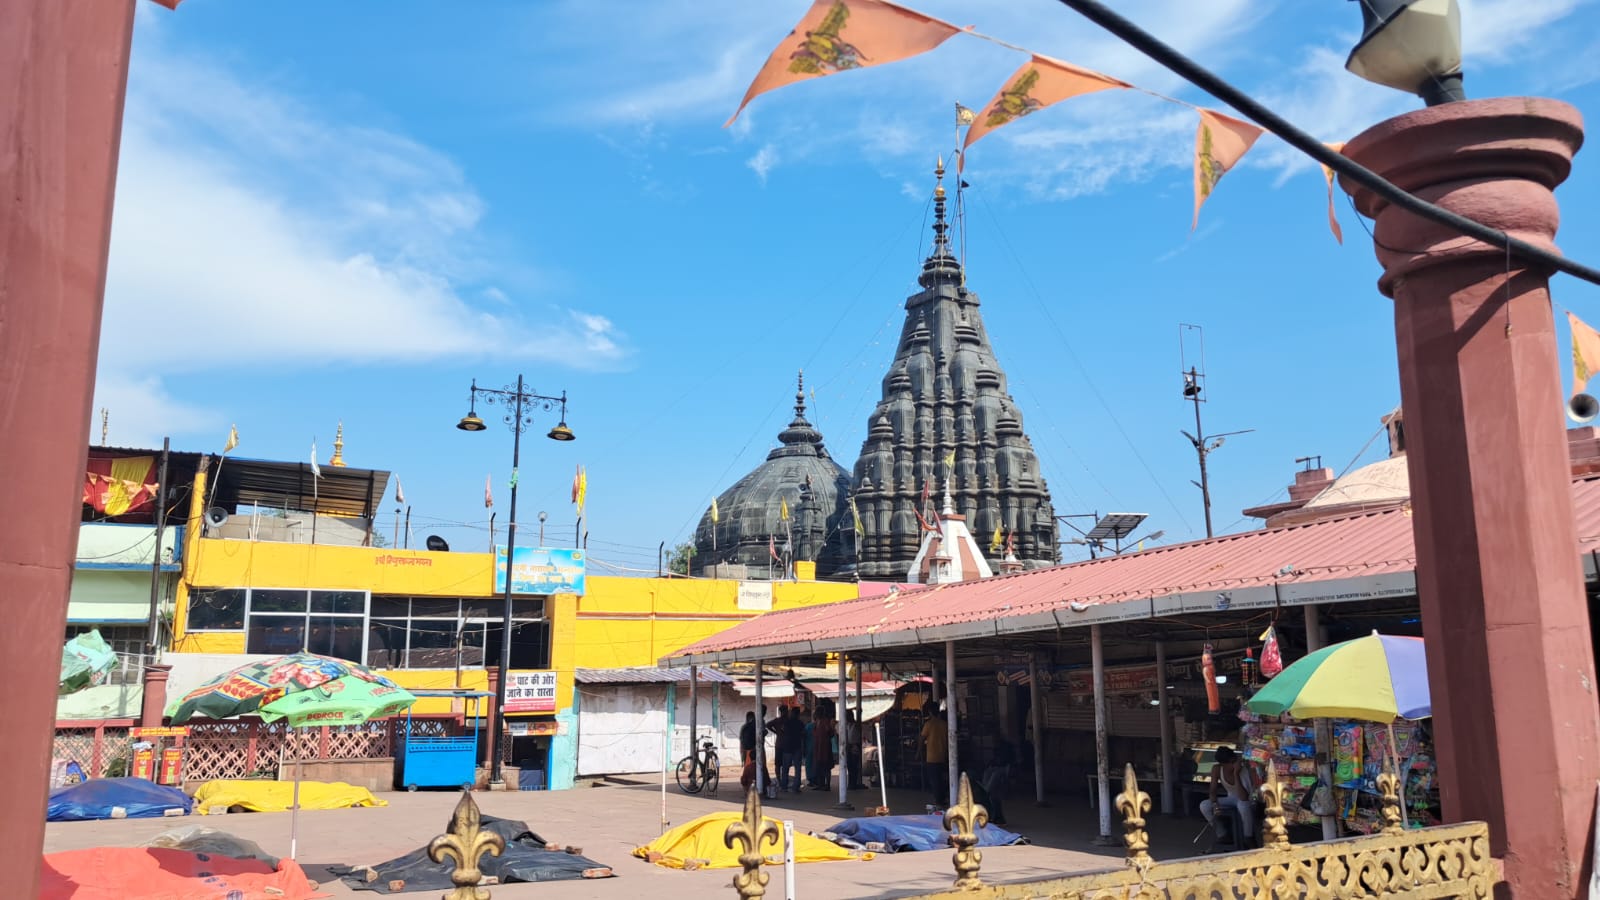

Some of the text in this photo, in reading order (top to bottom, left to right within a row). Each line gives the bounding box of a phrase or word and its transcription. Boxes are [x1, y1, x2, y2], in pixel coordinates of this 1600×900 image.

[517, 674, 554, 685] घाट की ओर
[506, 687, 554, 698] जाने का रास्ता
